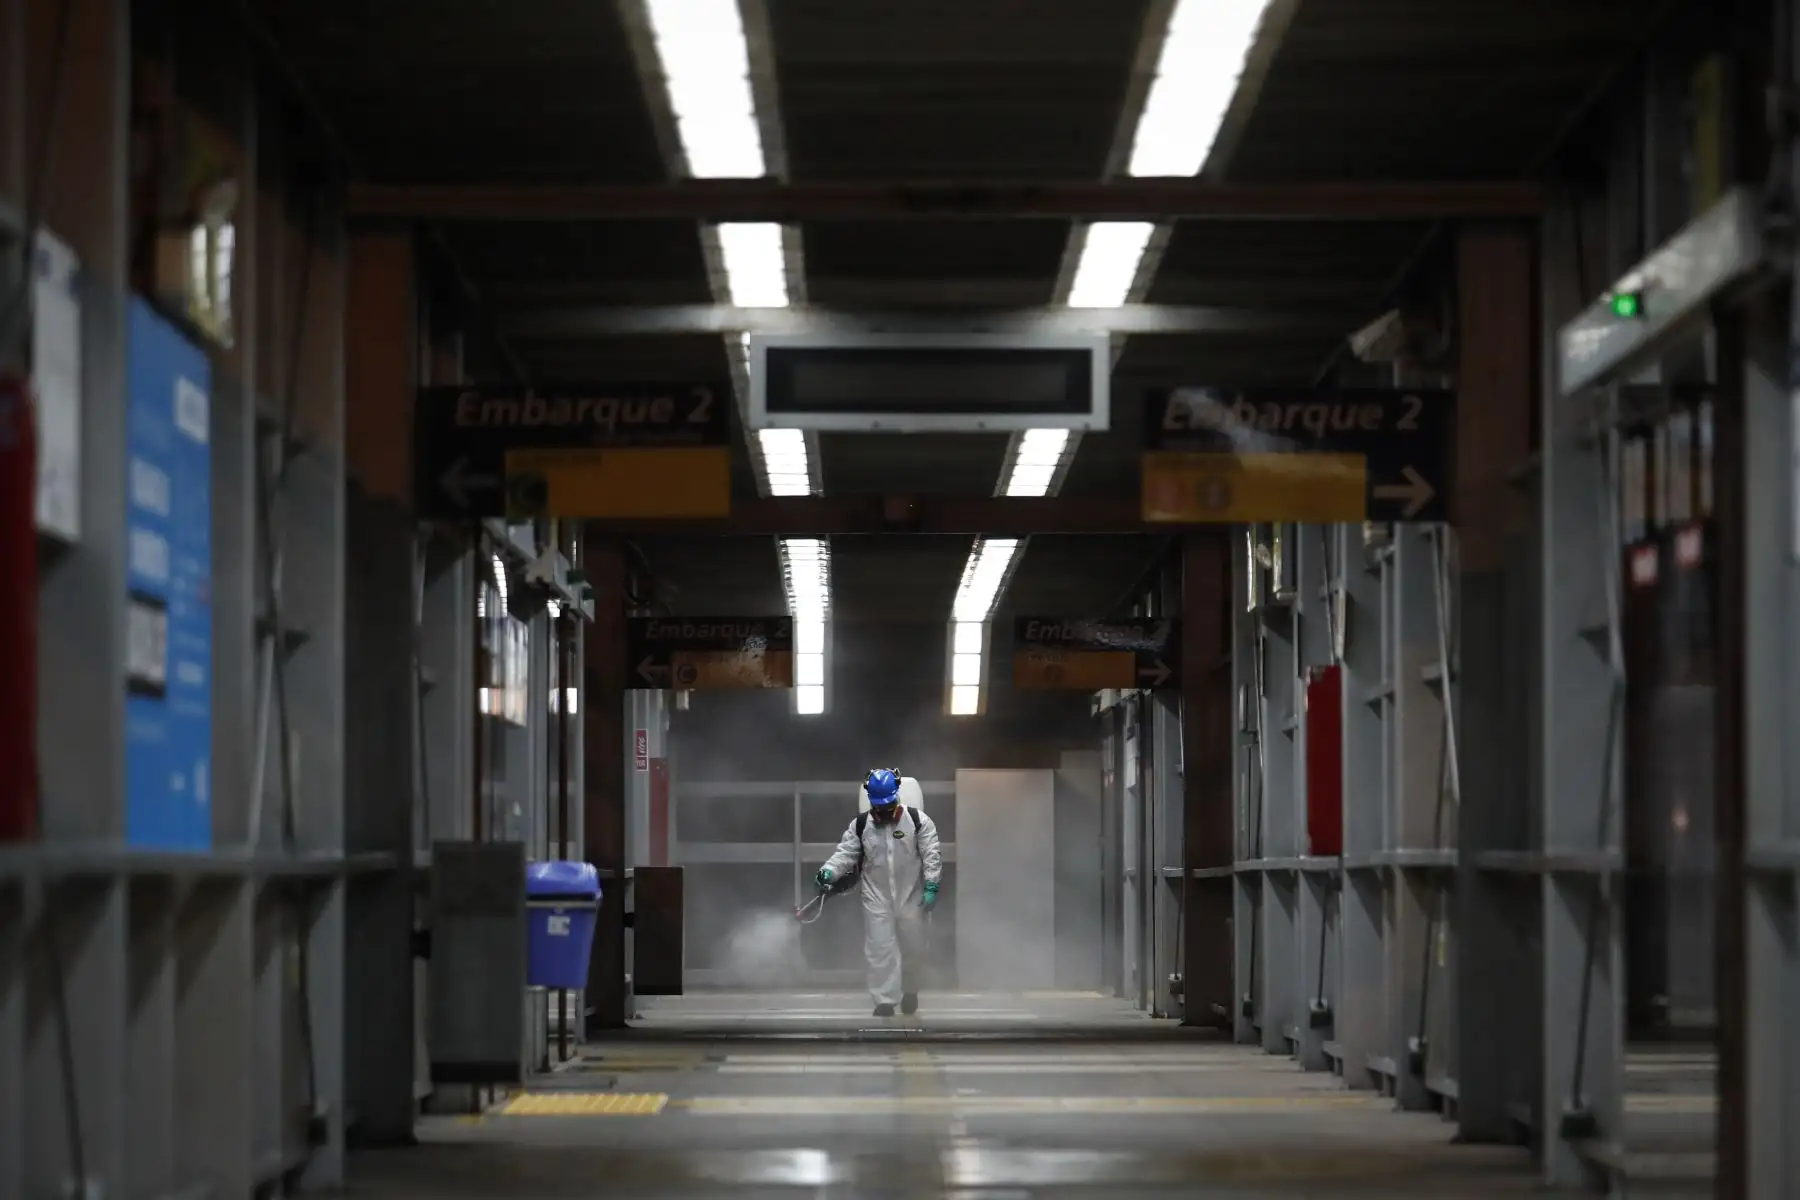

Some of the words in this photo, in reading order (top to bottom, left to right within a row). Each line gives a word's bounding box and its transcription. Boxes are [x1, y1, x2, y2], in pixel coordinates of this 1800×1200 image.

[455, 387, 675, 434] Embarque
[686, 387, 714, 424] 2
[1162, 389, 1385, 438] Ebarque
[1396, 394, 1424, 430] 2
